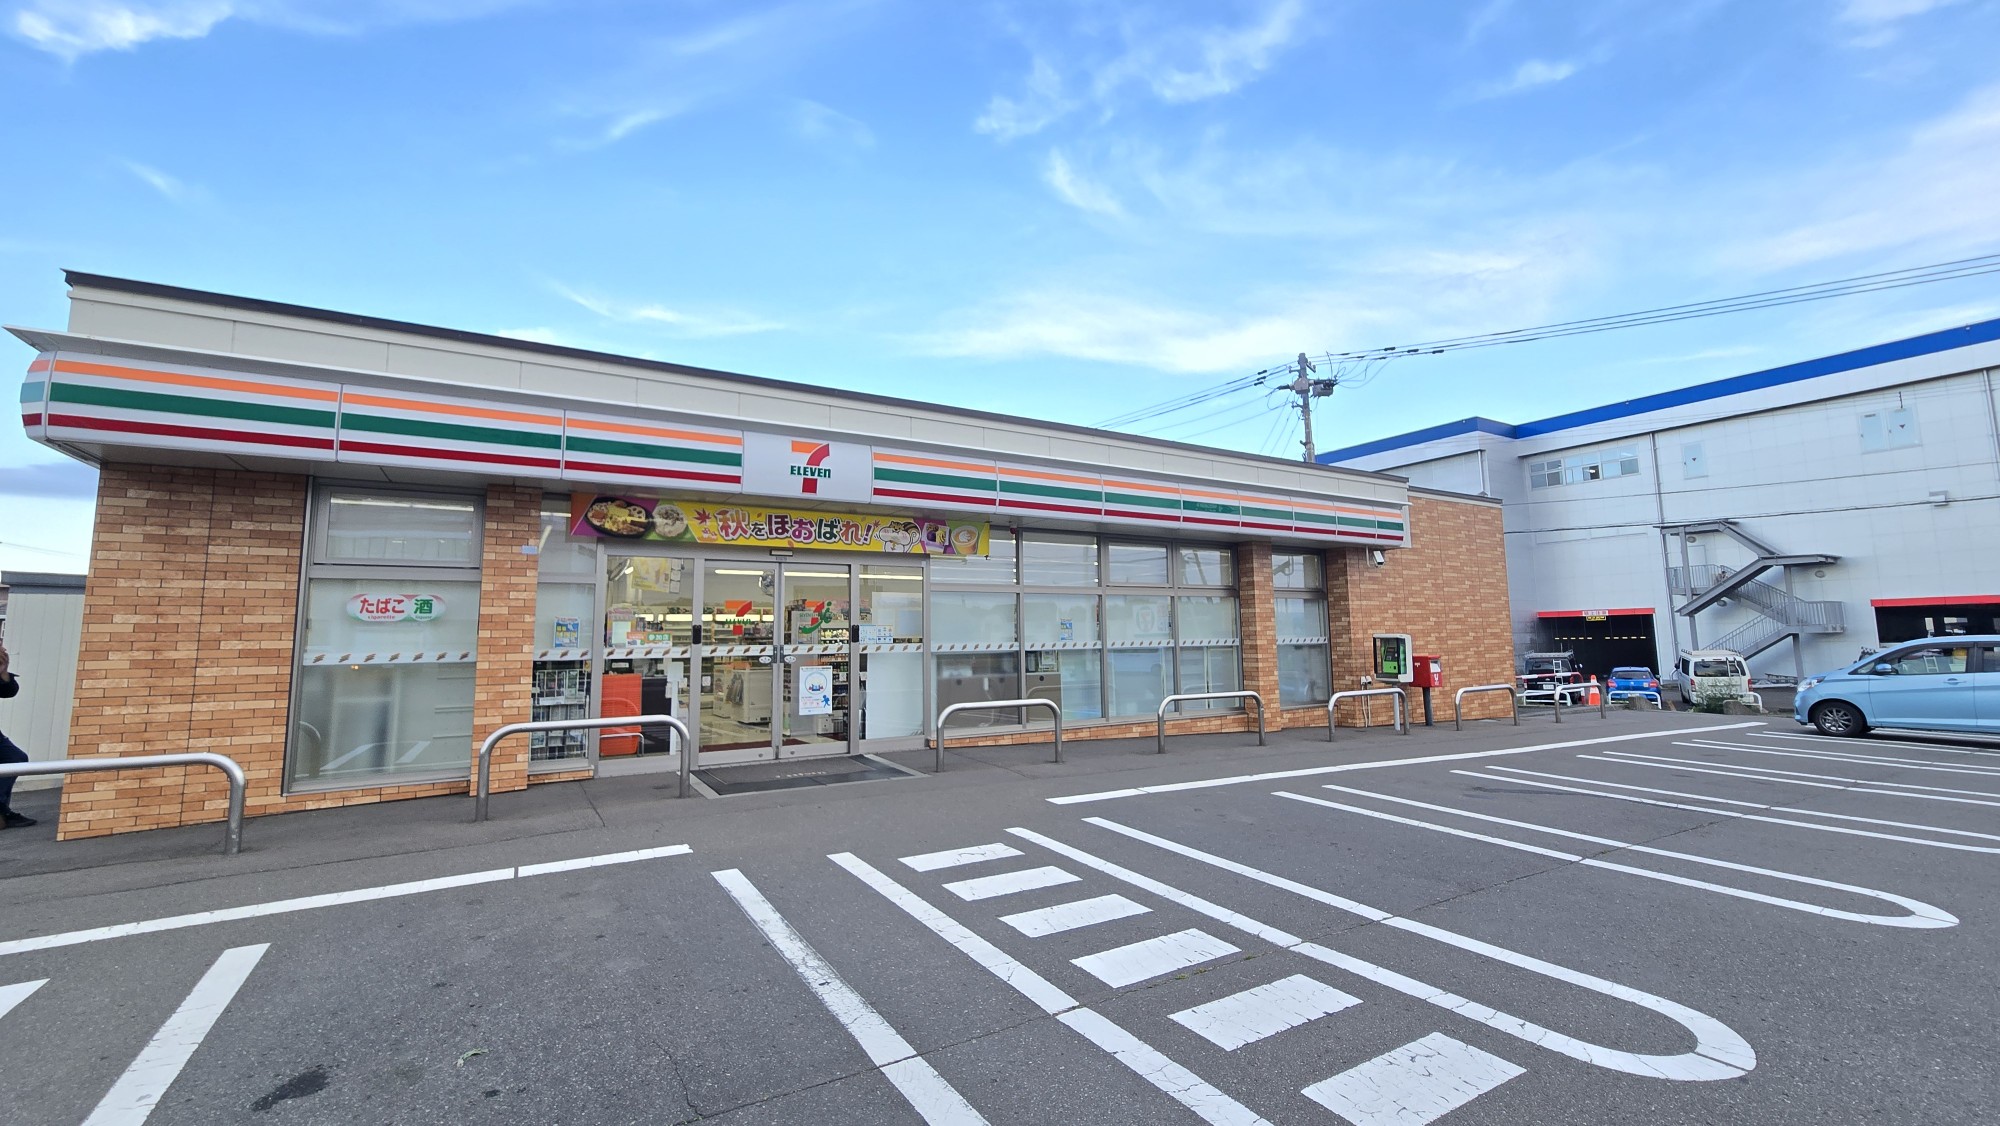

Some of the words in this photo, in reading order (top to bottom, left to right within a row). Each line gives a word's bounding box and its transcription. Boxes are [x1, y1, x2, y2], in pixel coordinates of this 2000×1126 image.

[715, 508, 874, 546] 秋をほおばれ!
[359, 598, 405, 614] たばこ
[414, 598, 434, 614] 酒
